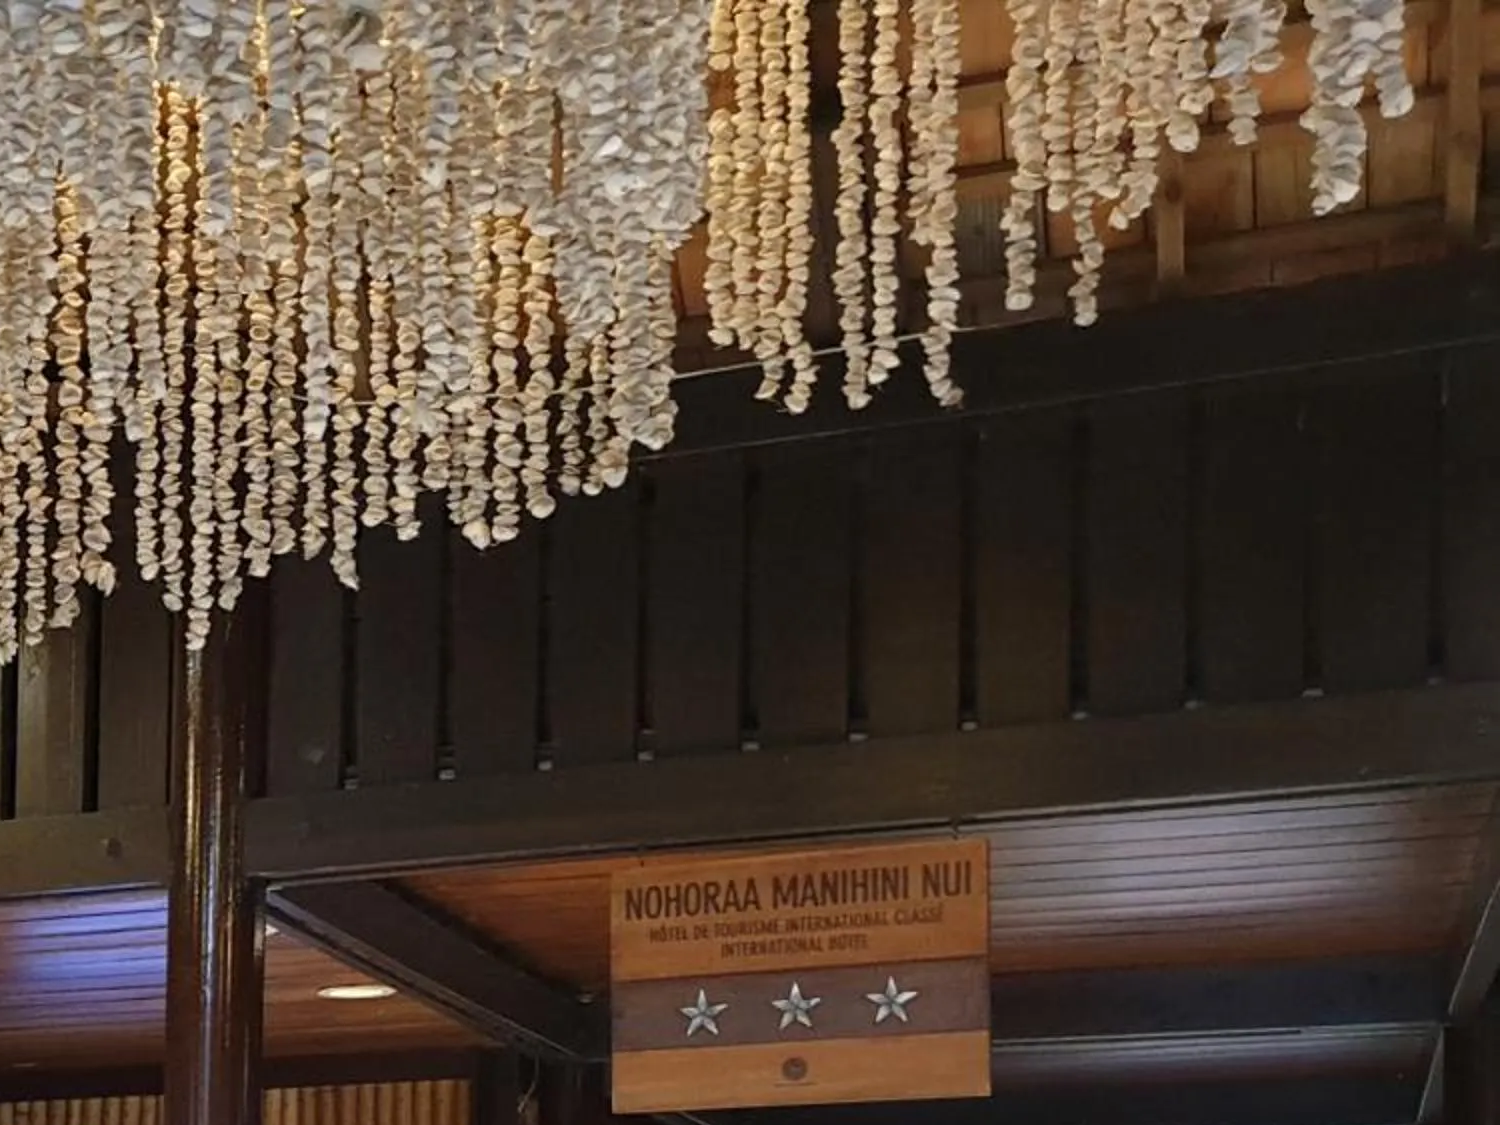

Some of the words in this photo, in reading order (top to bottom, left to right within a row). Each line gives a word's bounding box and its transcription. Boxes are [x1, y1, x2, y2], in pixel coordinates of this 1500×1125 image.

[625, 877, 762, 920] NOHORAA
[772, 865, 909, 909] MANIHINI
[922, 860, 971, 898] NUI
[694, 923, 708, 940] DE
[714, 918, 779, 938] TOURISME
[785, 910, 889, 933] INTERNATIONAL
[720, 937, 823, 959] INTERNATIONAL
